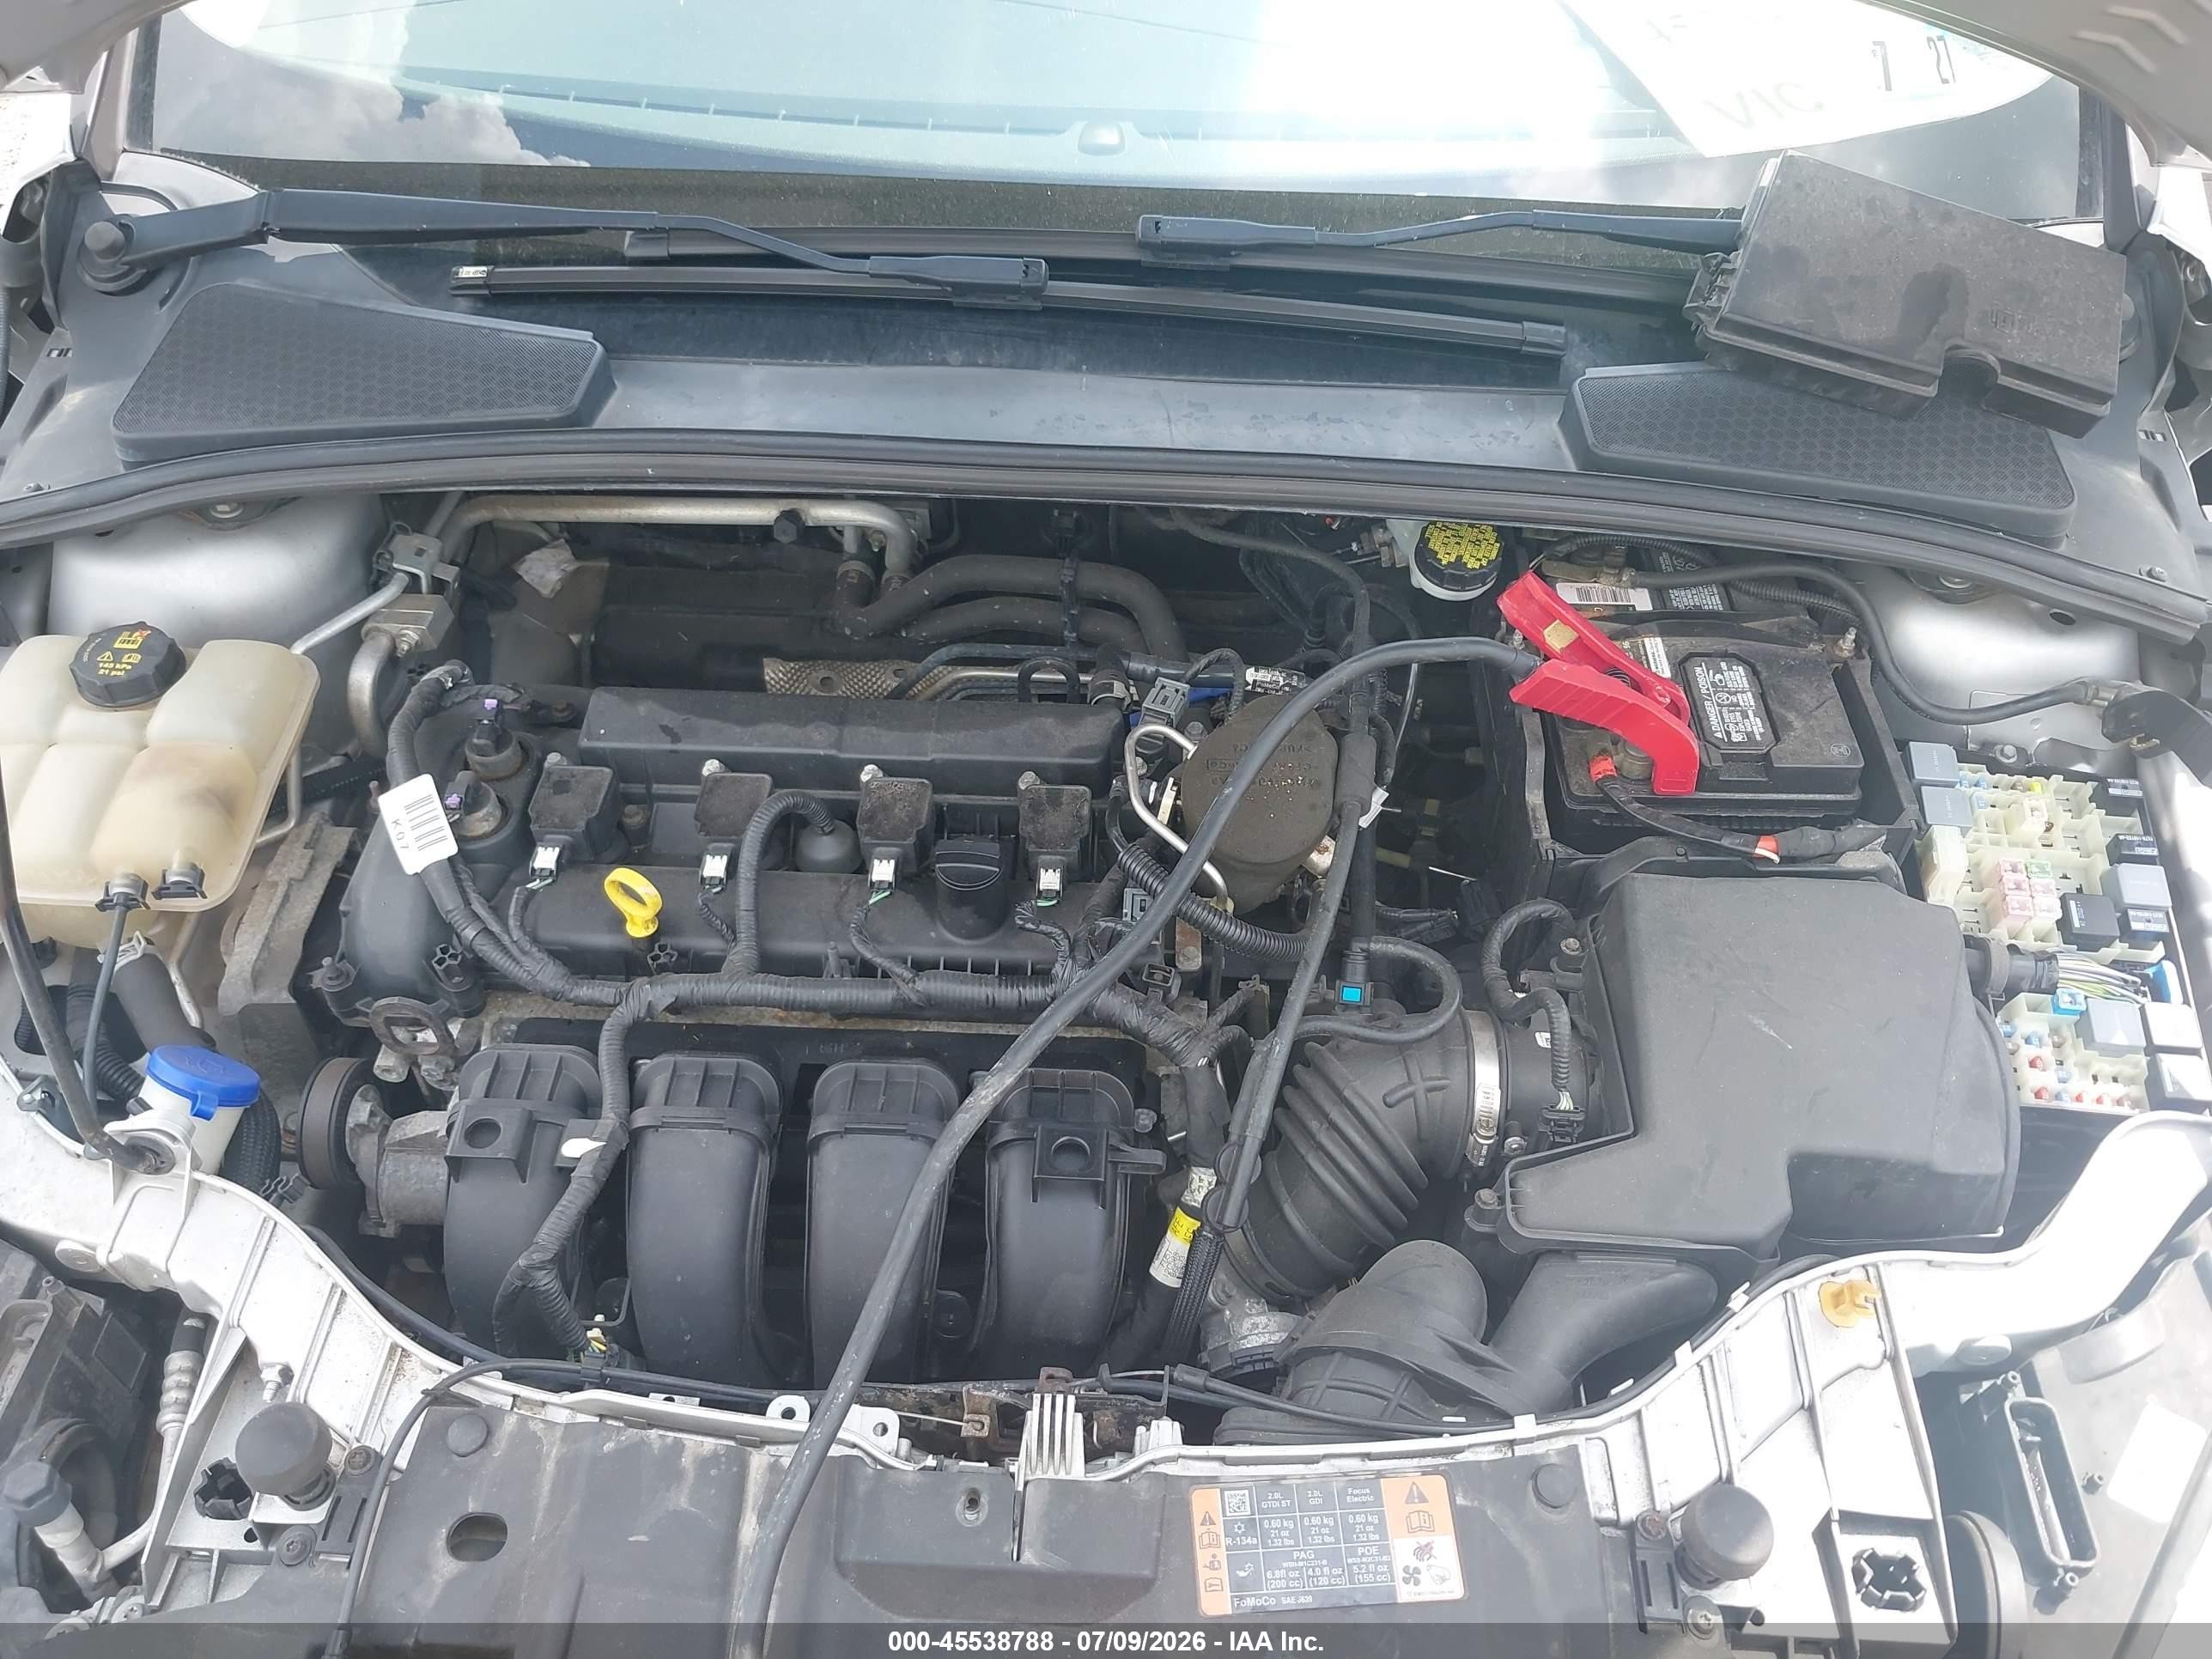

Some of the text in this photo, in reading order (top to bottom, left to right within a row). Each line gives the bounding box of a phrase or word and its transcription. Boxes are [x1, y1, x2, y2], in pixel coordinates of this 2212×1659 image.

[1694, 666, 1710, 693] POISON
[1705, 701, 1720, 731] DANGER
[1267, 1492, 1285, 1500] 2.0L
[1346, 1494, 1375, 1503] Electric
[1264, 1518, 1294, 1529] 0.60 kg
[1304, 1516, 1334, 1527] 0.60 kg
[1348, 1513, 1379, 1524] 0.60 kg
[1226, 1535, 1258, 1546] R-134a
[1323, 1534, 1335, 1543] lbs
[1368, 1532, 1379, 1540] lbs
[1293, 1550, 1315, 1560] PAG
[1358, 1546, 1380, 1556] POE
[1307, 1567, 1321, 1577] 4.0
[1323, 1566, 1330, 1575] fl
[1353, 1565, 1367, 1574] 5.2
[1369, 1564, 1375, 1572] fl
[1310, 1575, 1346, 1587] (120 cc)
[1355, 1571, 1390, 1584] (155 cc)
[1267, 1578, 1303, 1590] (200 cc)
[1234, 1596, 1276, 1607] FoMoCo
